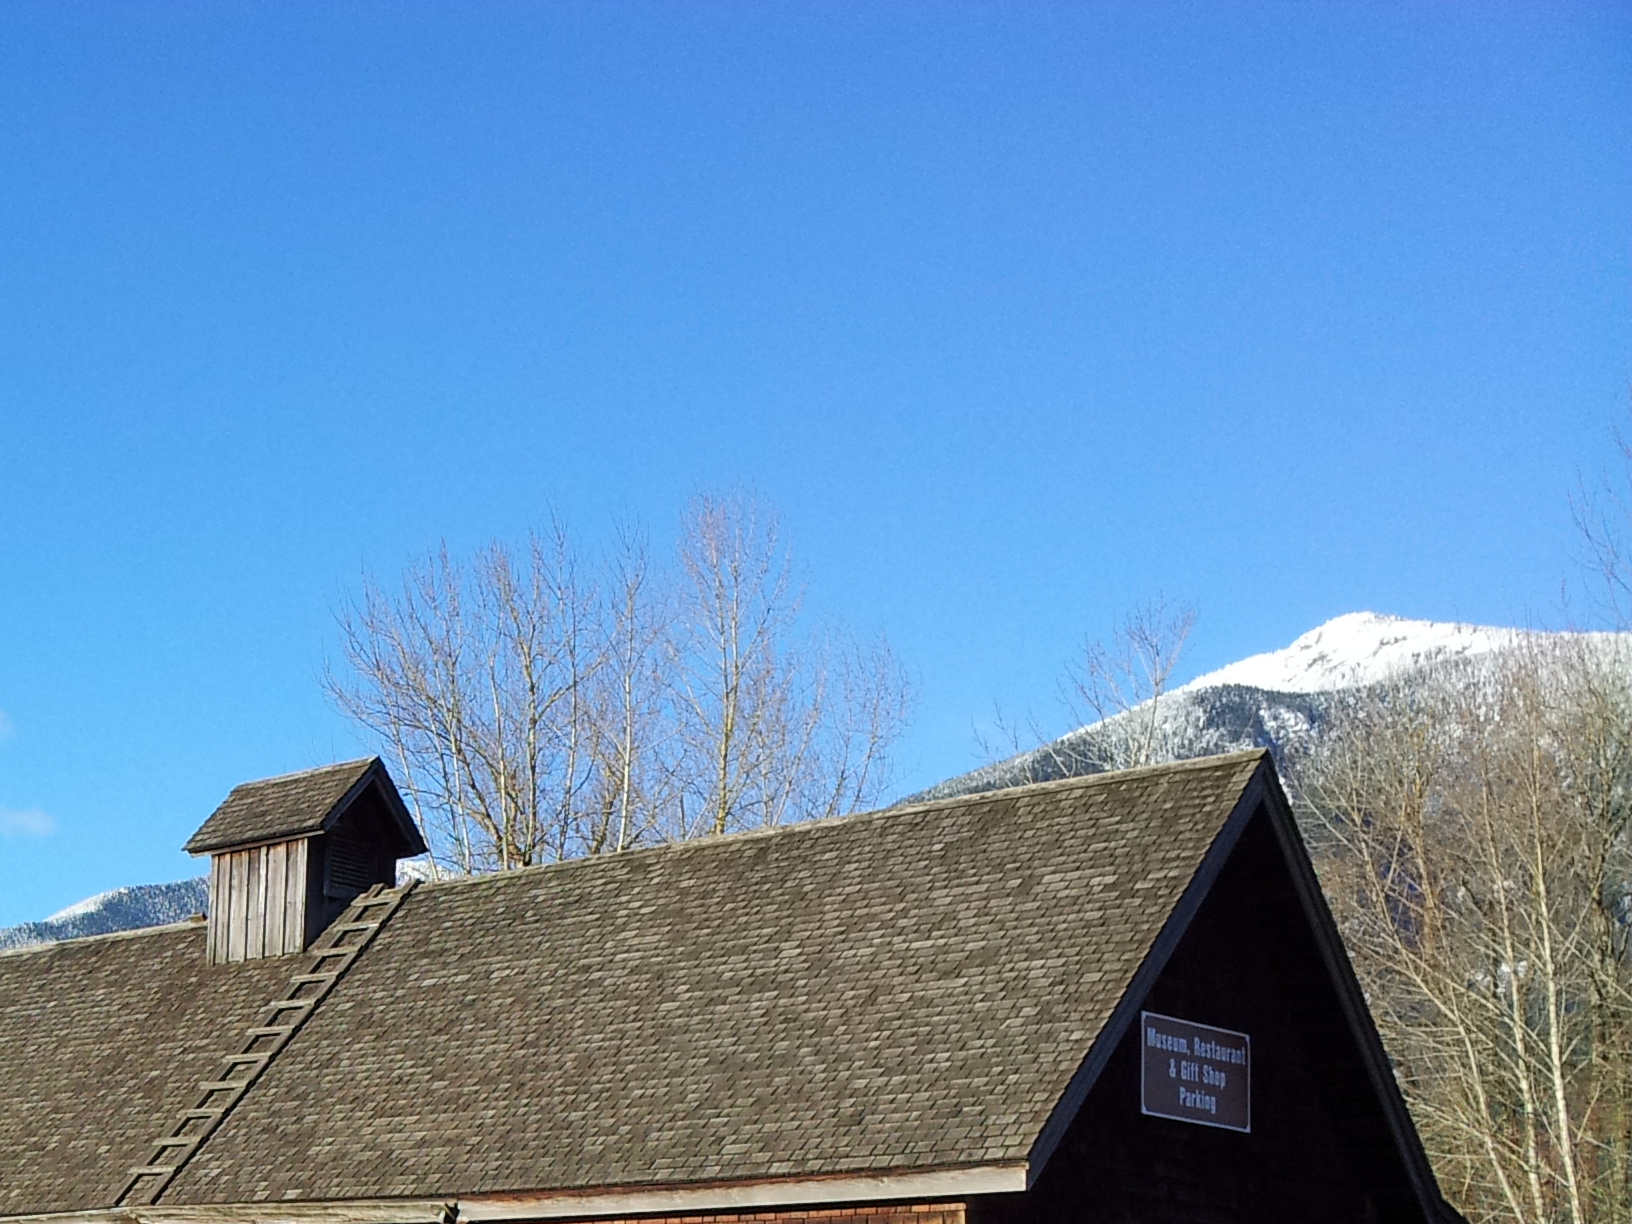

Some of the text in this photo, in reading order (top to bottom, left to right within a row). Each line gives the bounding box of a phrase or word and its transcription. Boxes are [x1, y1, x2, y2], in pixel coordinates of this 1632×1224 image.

[1147, 1027, 1246, 1066] Museum, Restaurant
[1169, 1058, 1226, 1090] & Gift Shop
[1179, 1086, 1217, 1115] Parking
